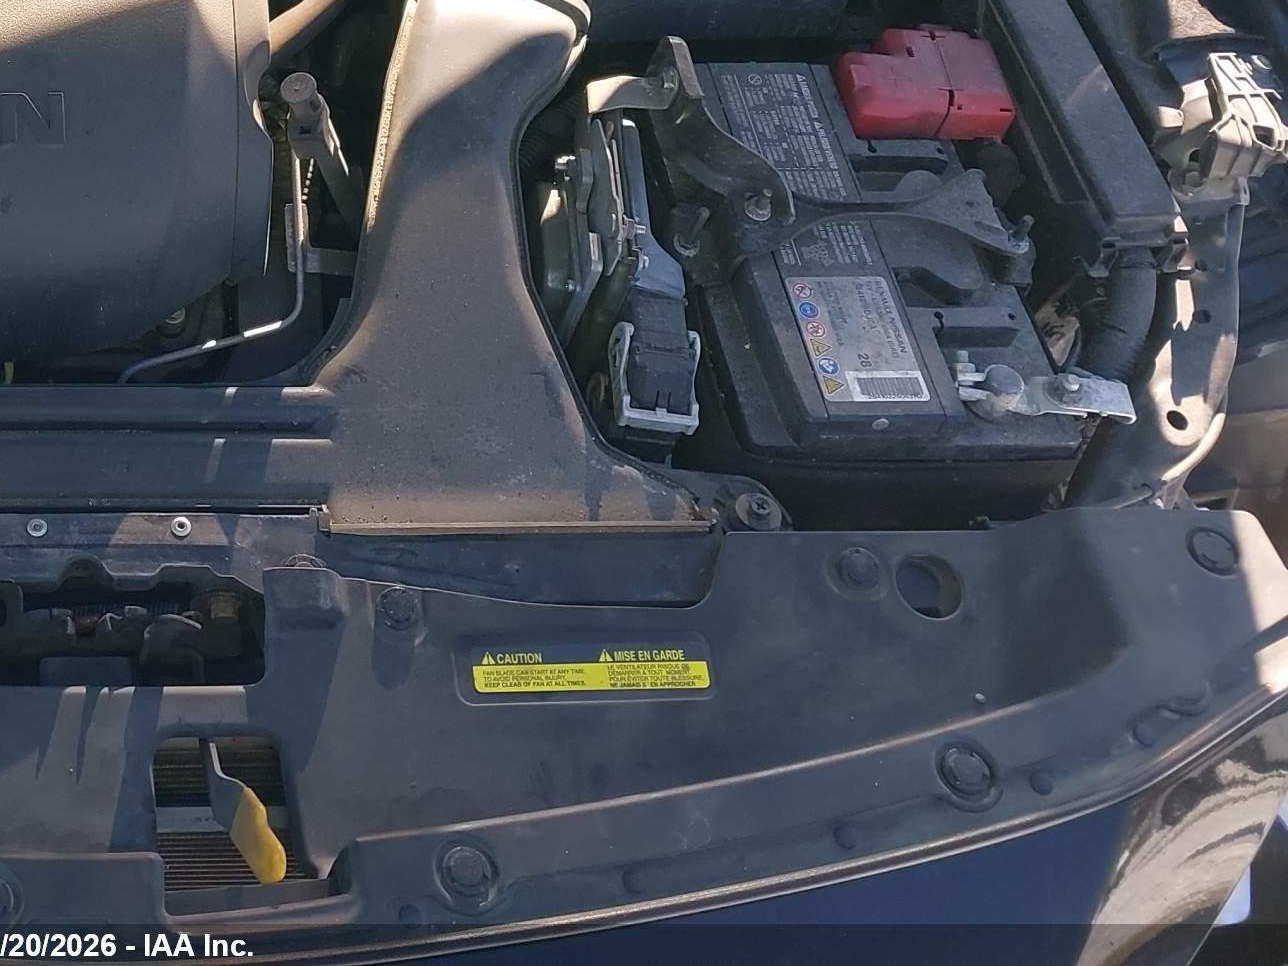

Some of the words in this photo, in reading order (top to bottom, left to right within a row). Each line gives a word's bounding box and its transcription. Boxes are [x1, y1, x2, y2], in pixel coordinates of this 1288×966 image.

[888, 316, 908, 354] NISSAN
[857, 353, 872, 368] 28
[496, 652, 543, 664] CAUTION
[614, 650, 637, 662] MISE
[638, 650, 651, 661] EN
[653, 649, 686, 661] GARDE
